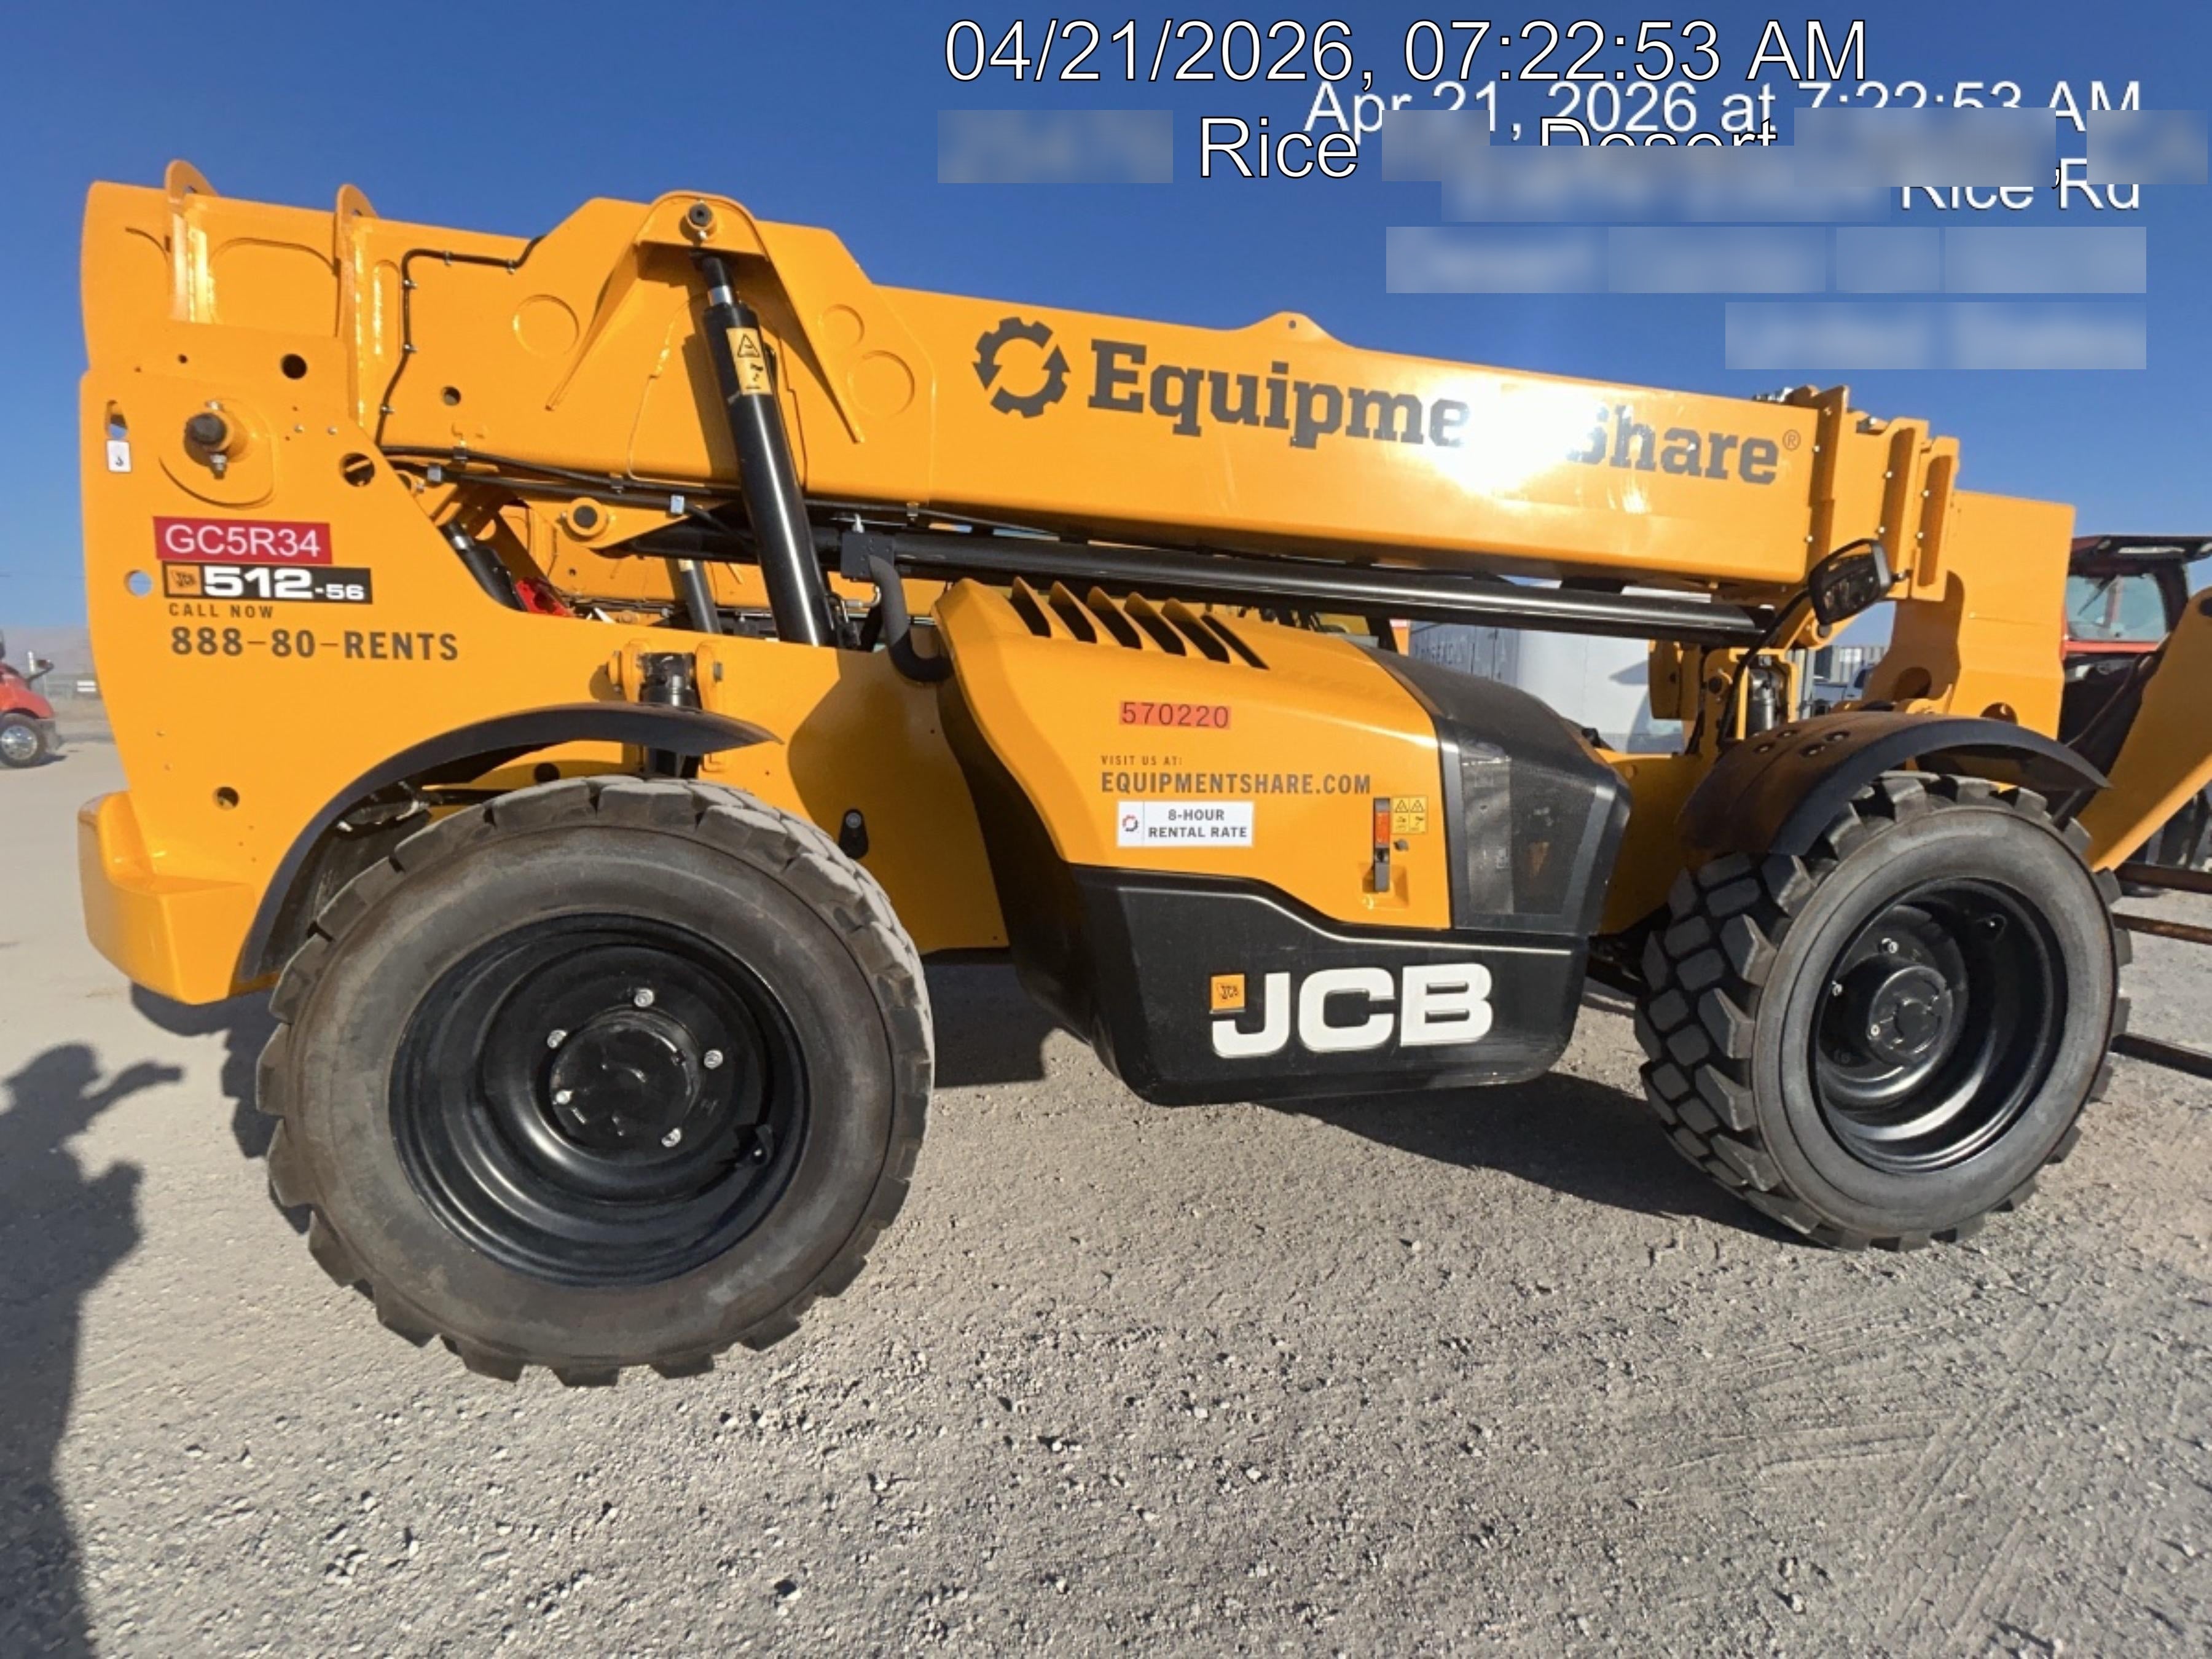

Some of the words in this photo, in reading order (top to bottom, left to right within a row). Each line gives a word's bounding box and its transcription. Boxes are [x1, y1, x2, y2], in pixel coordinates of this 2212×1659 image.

[165, 524, 321, 557] GC5R34
[203, 565, 365, 600] 512-56
[168, 602, 219, 618] CALL
[230, 605, 274, 619] NOW
[171, 626, 459, 661] 888-80-RENTS
[1121, 701, 1229, 728] 570220
[1101, 756, 1135, 766] VISIT
[1142, 756, 1157, 766] US
[1101, 771, 1371, 794] EQUIPMENTSHARE.COM
[1168, 809, 1225, 821] 8-HOUR
[1148, 826, 1206, 837] RENTAL
[1210, 826, 1247, 837] RATE
[1212, 963, 1493, 1058] JCB
